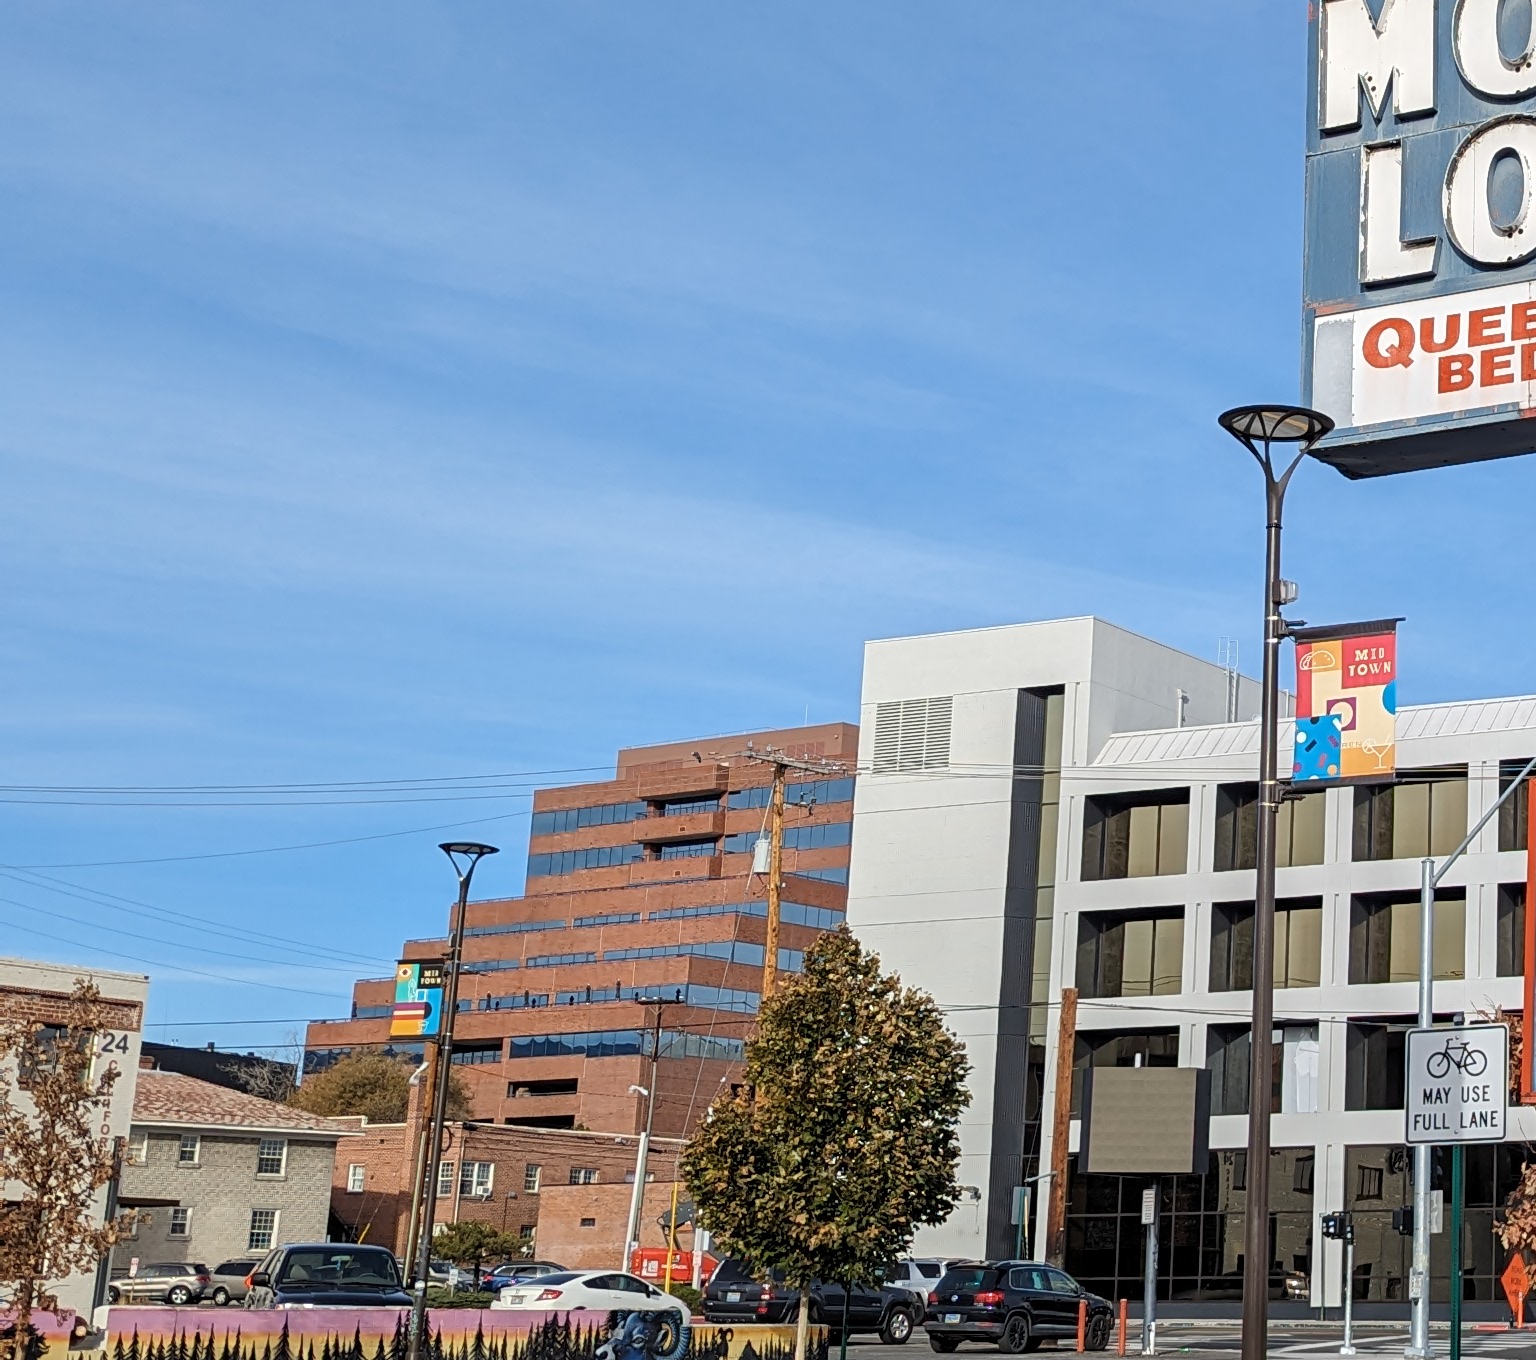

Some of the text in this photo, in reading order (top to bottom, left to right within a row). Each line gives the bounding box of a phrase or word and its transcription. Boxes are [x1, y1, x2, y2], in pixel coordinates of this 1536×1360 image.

[1354, 647, 1385, 661] MID
[1348, 660, 1392, 677] TOWN
[101, 1032, 129, 1054] 24
[1423, 1085, 1490, 1105] MAY USE
[1414, 1110, 1498, 1131] FULL LANE
